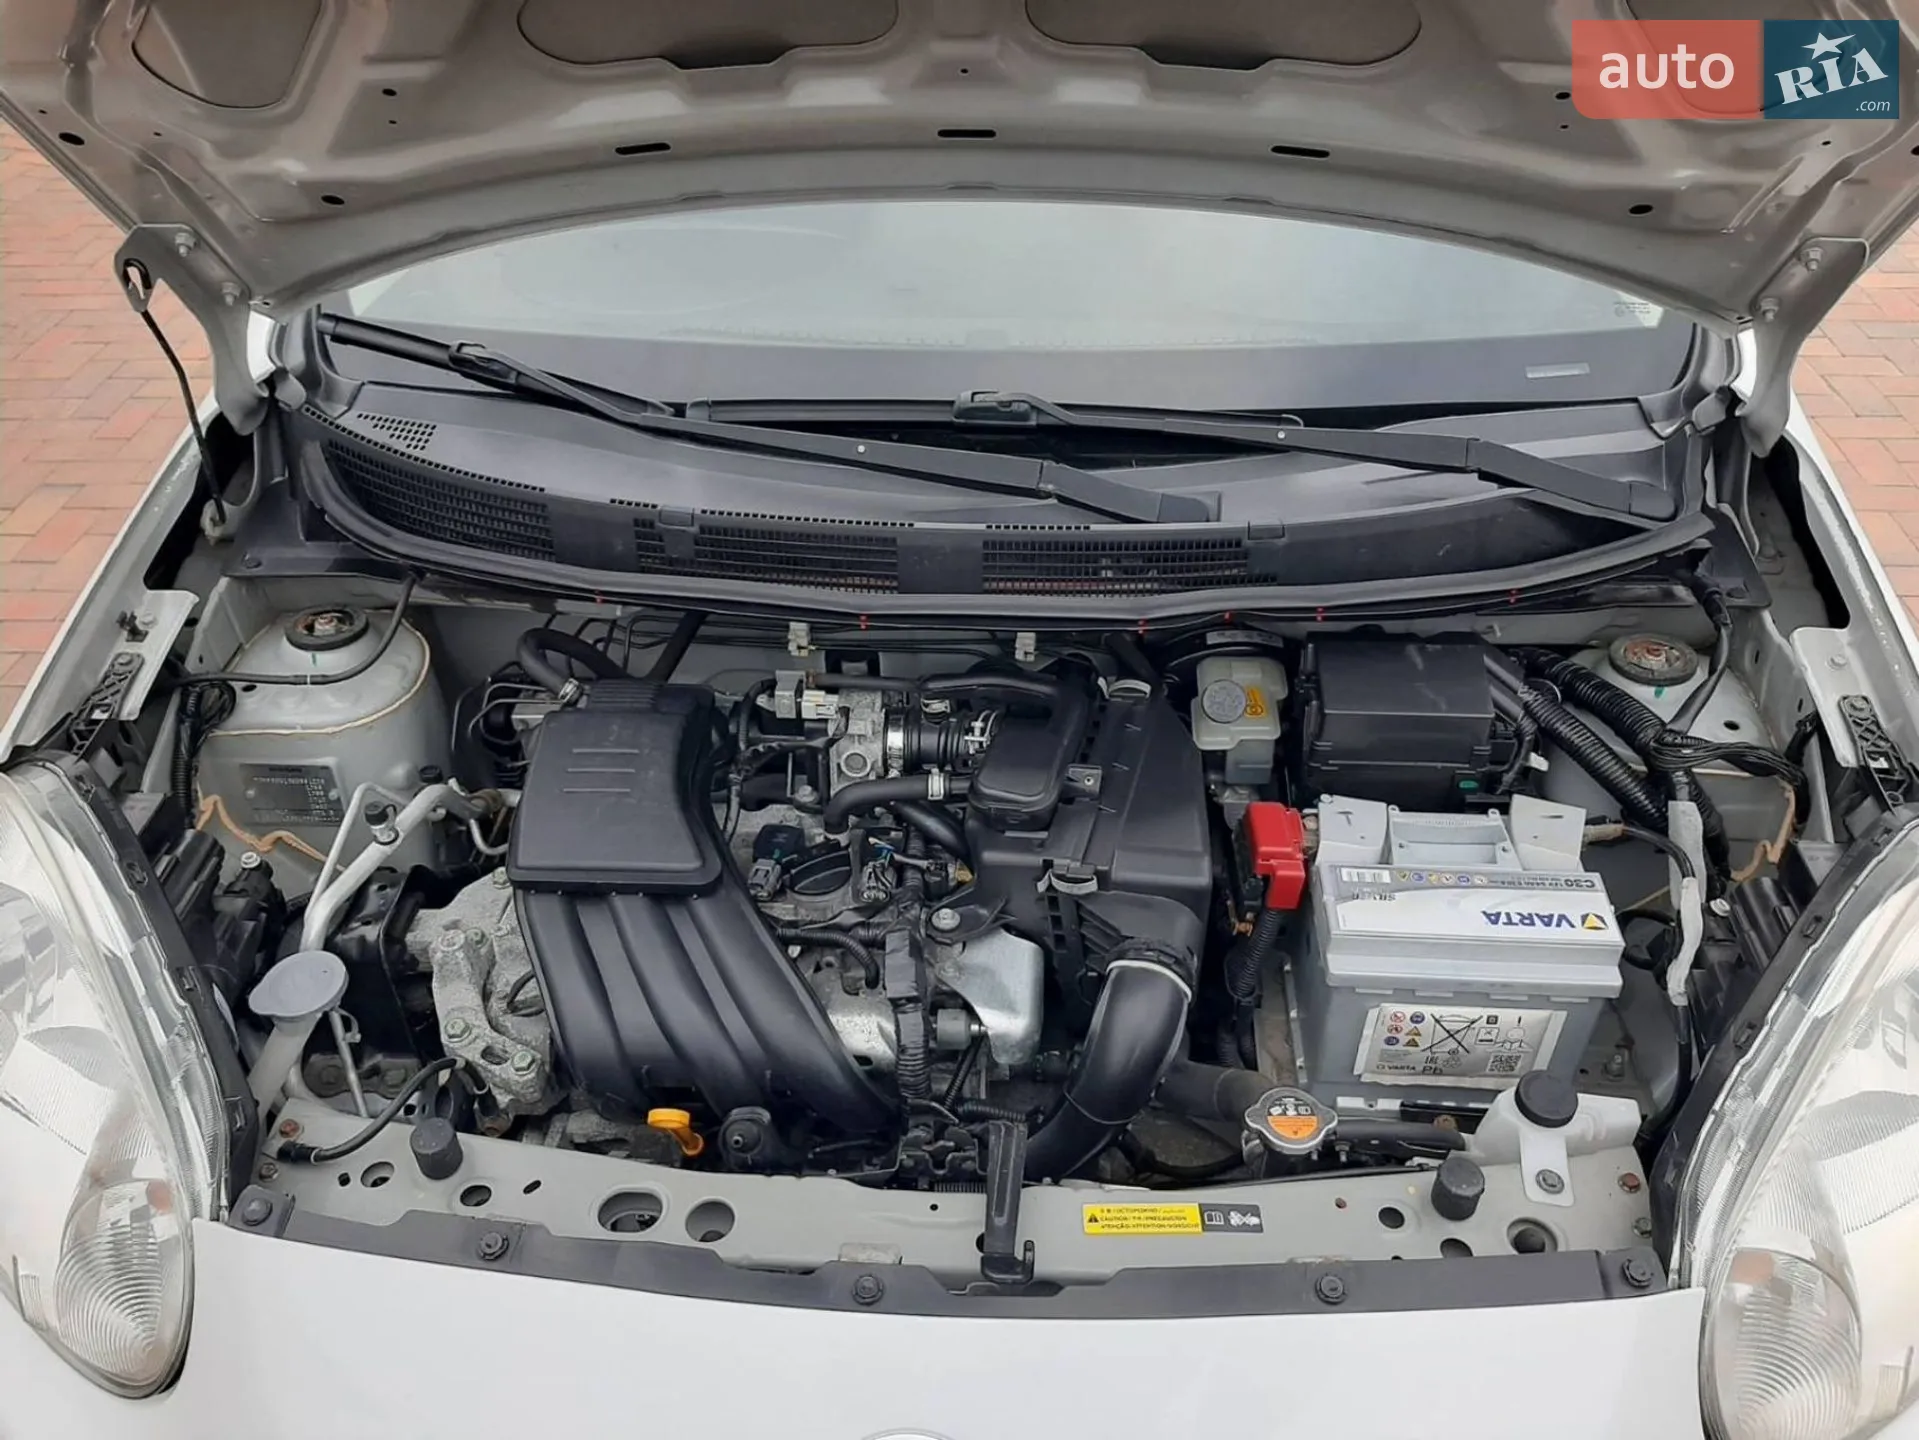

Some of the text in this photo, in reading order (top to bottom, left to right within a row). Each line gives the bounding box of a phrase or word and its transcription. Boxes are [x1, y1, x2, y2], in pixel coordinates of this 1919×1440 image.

[1564, 878, 1596, 889] C30
[1481, 910, 1576, 929] VARTA
[1421, 1065, 1444, 1075] Pb
